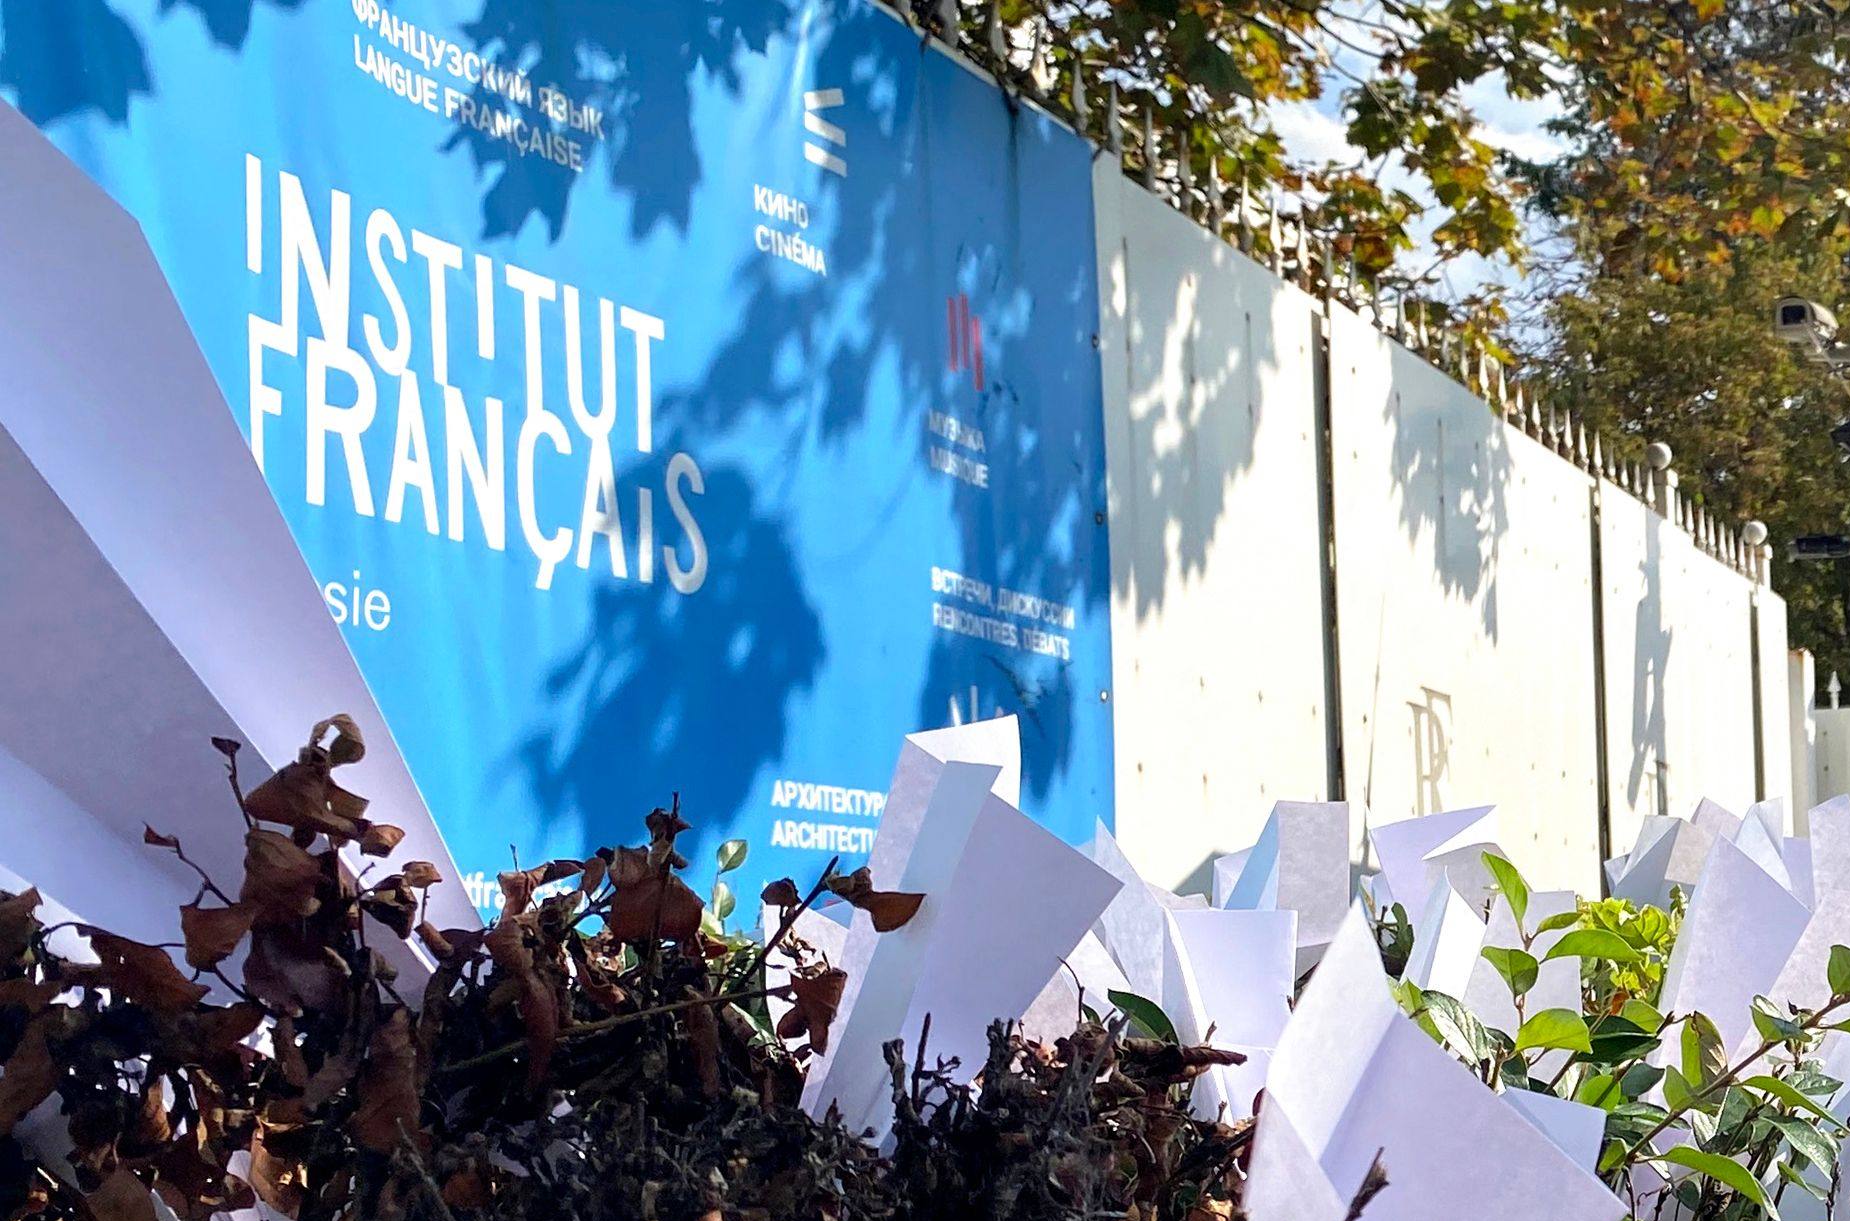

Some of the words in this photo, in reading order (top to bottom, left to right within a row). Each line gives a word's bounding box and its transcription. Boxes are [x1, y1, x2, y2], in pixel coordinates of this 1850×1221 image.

[352, 0, 532, 108] ФРАНЦУЗСКИЙ
[538, 85, 605, 140] ЯЗЫК
[353, 34, 439, 114] LANGUE
[444, 87, 584, 173] FRANÇAISE
[754, 184, 809, 229] КИНО
[755, 224, 827, 277] CINÉMA
[246, 153, 664, 453] INSTITUT
[771, 779, 888, 817] АРХИТЕКТУР
